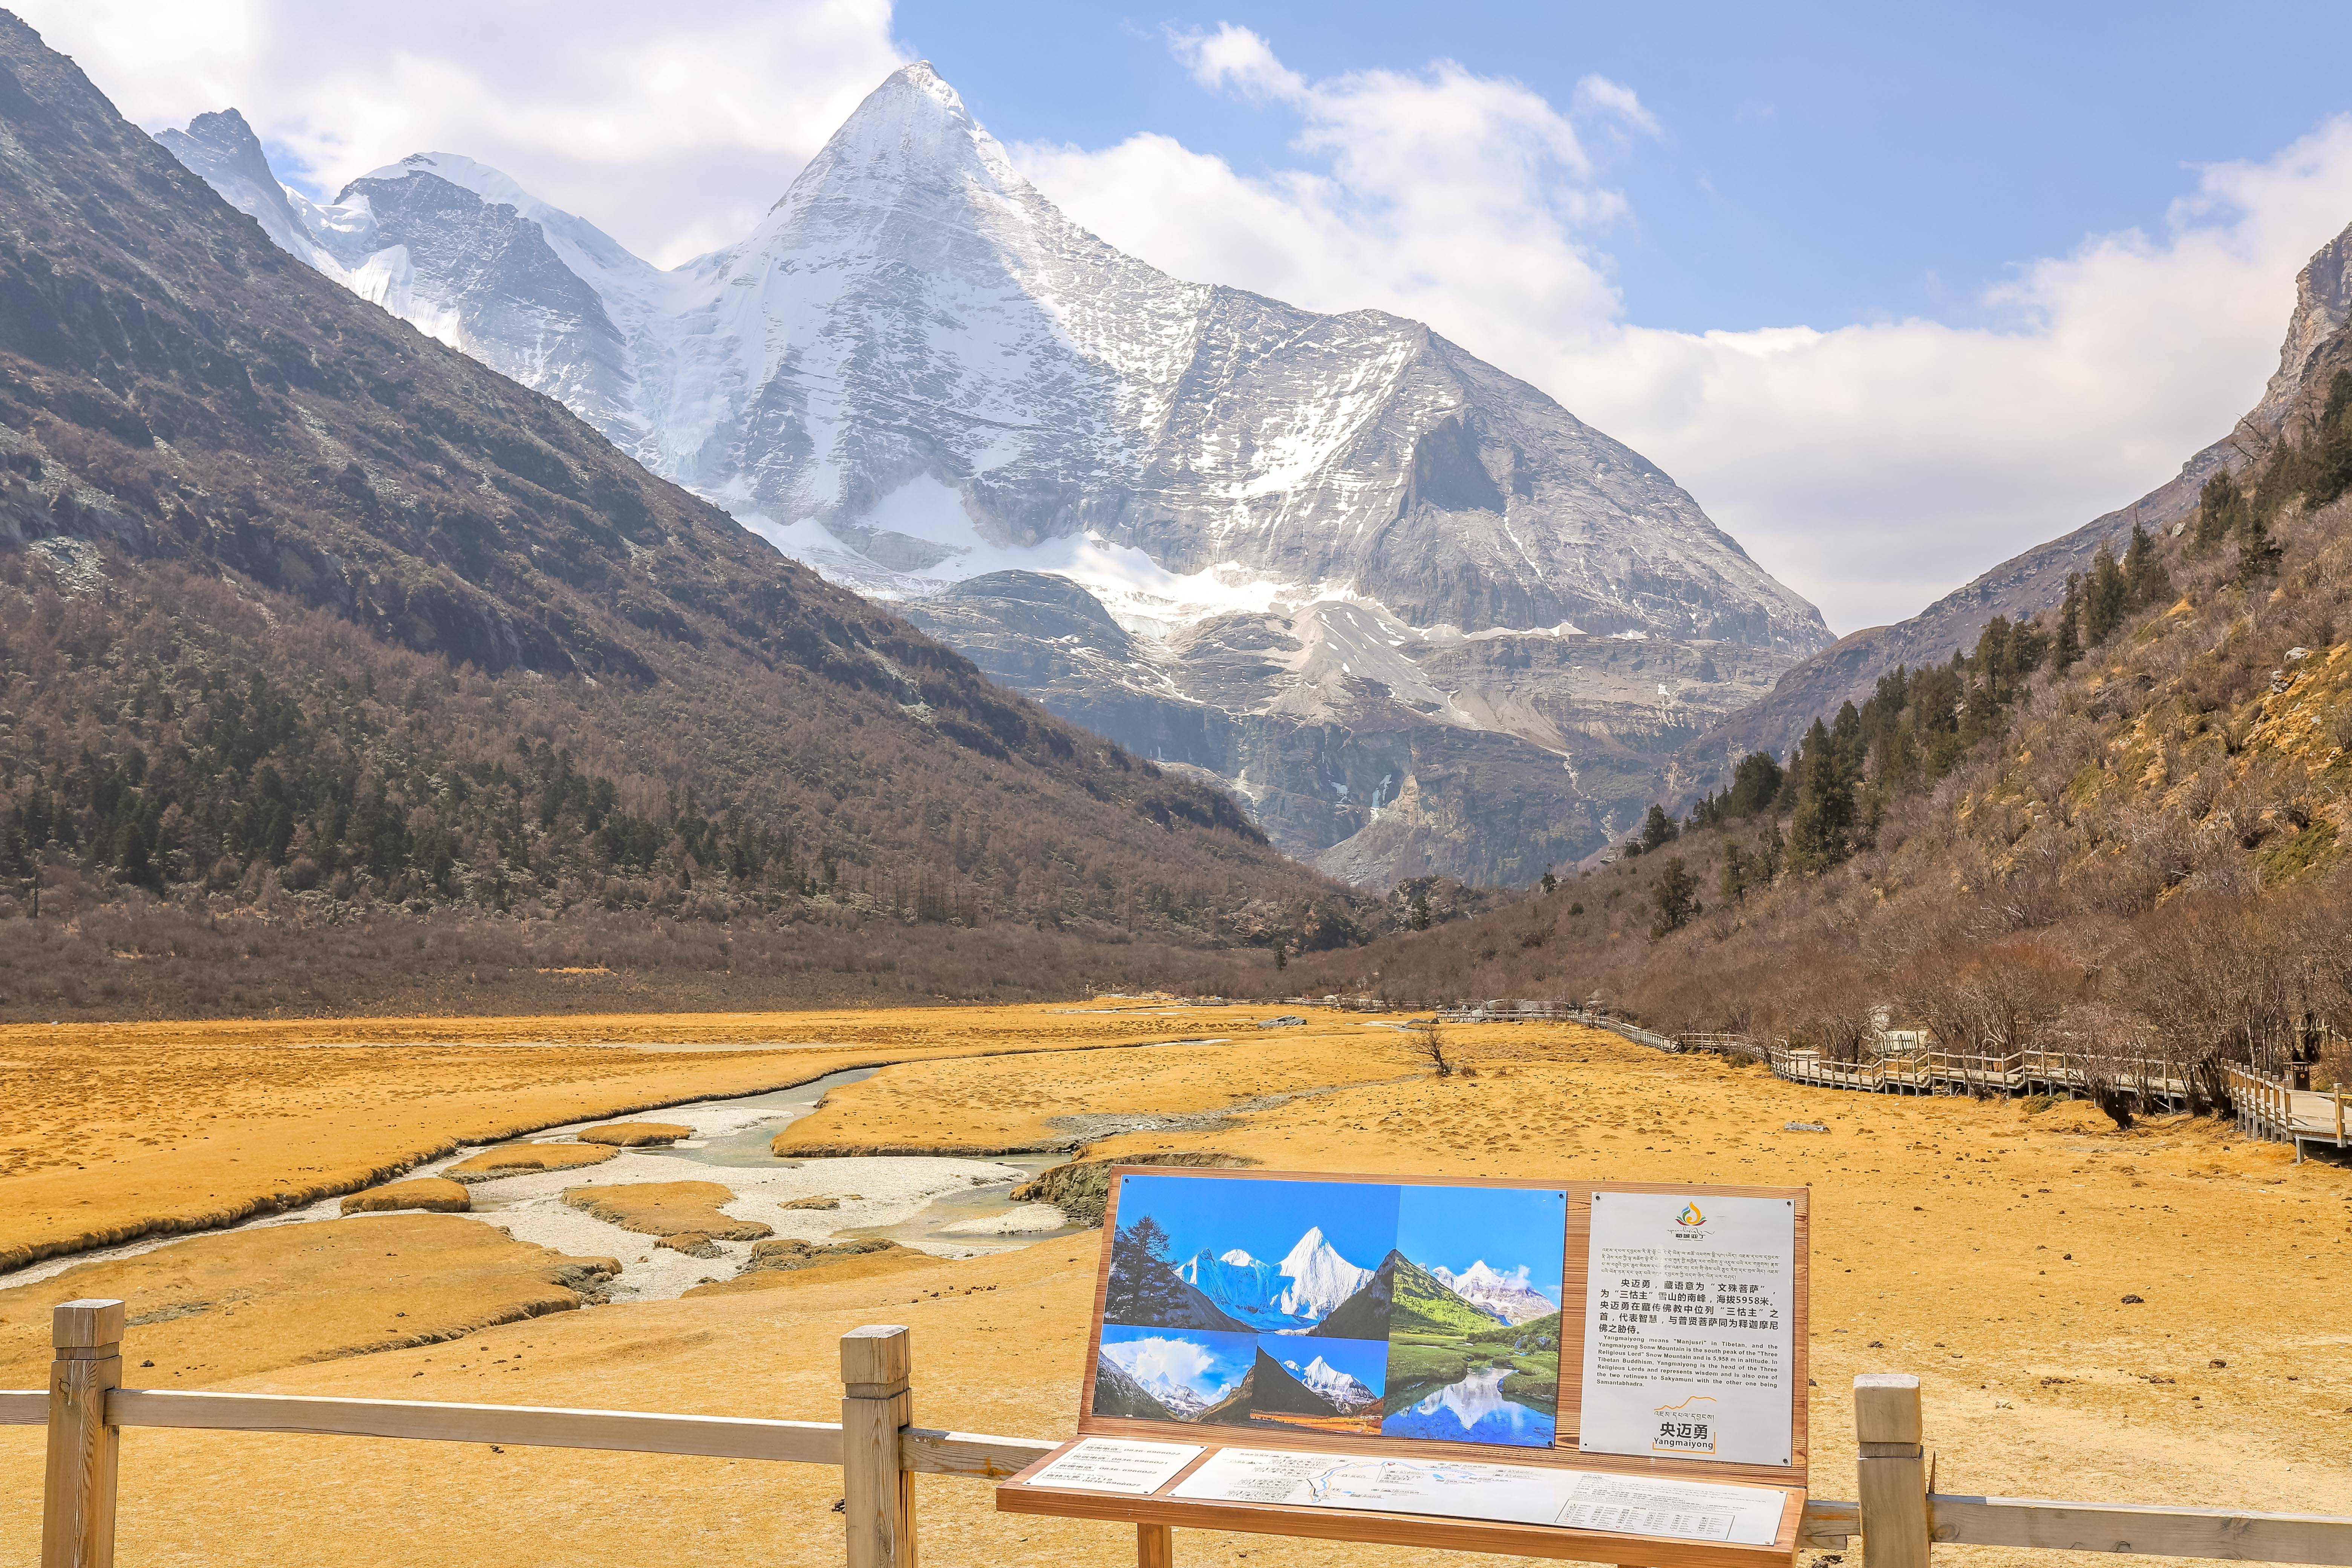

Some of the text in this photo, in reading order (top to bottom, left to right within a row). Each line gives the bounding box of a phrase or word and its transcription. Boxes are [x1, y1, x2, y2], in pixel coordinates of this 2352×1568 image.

[1599, 1311, 1778, 1330] 首，代表智慧，与普贤菩萨同为释迦摩尼
[1599, 1323, 1640, 1334] 佛之胁侍。
[1603, 1334, 1645, 1343] Yangmaiyong
[1598, 1341, 1638, 1350] Yangmaiyong
[1656, 1360, 1697, 1369] Yangmaiyong
[1596, 1378, 1644, 1387] Samantabhadra.
[1660, 1421, 1707, 1439] 央迈勇
[1653, 1437, 1713, 1450] Yangmaiyong
